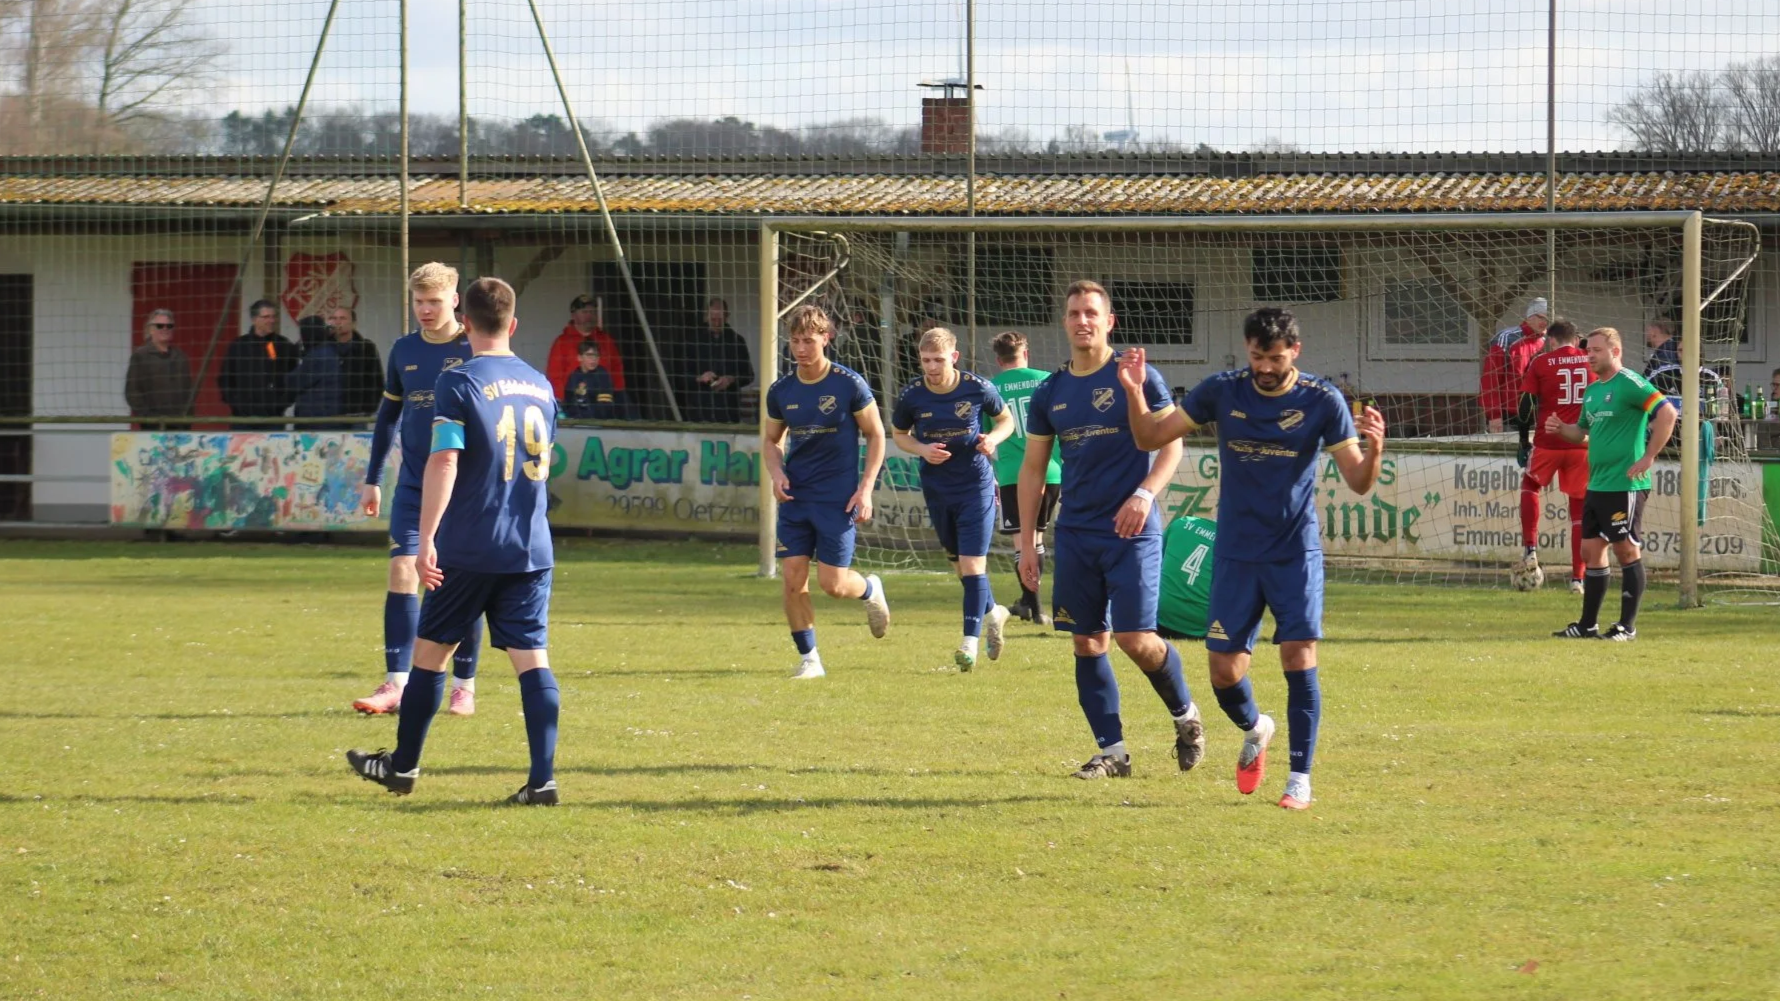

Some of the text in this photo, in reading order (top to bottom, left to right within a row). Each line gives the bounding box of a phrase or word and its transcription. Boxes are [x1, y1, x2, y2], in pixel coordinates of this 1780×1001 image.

[484, 381, 500, 400] SV
[1557, 368, 1588, 404] 32
[496, 405, 549, 482] 19
[577, 436, 689, 490] Agrar
[673, 497, 760, 523] Oetzen
[1453, 500, 1482, 518] Inh.
[1544, 503, 1571, 521] Sc
[1453, 524, 1567, 549] Emmenorf
[1180, 543, 1210, 586] 4
